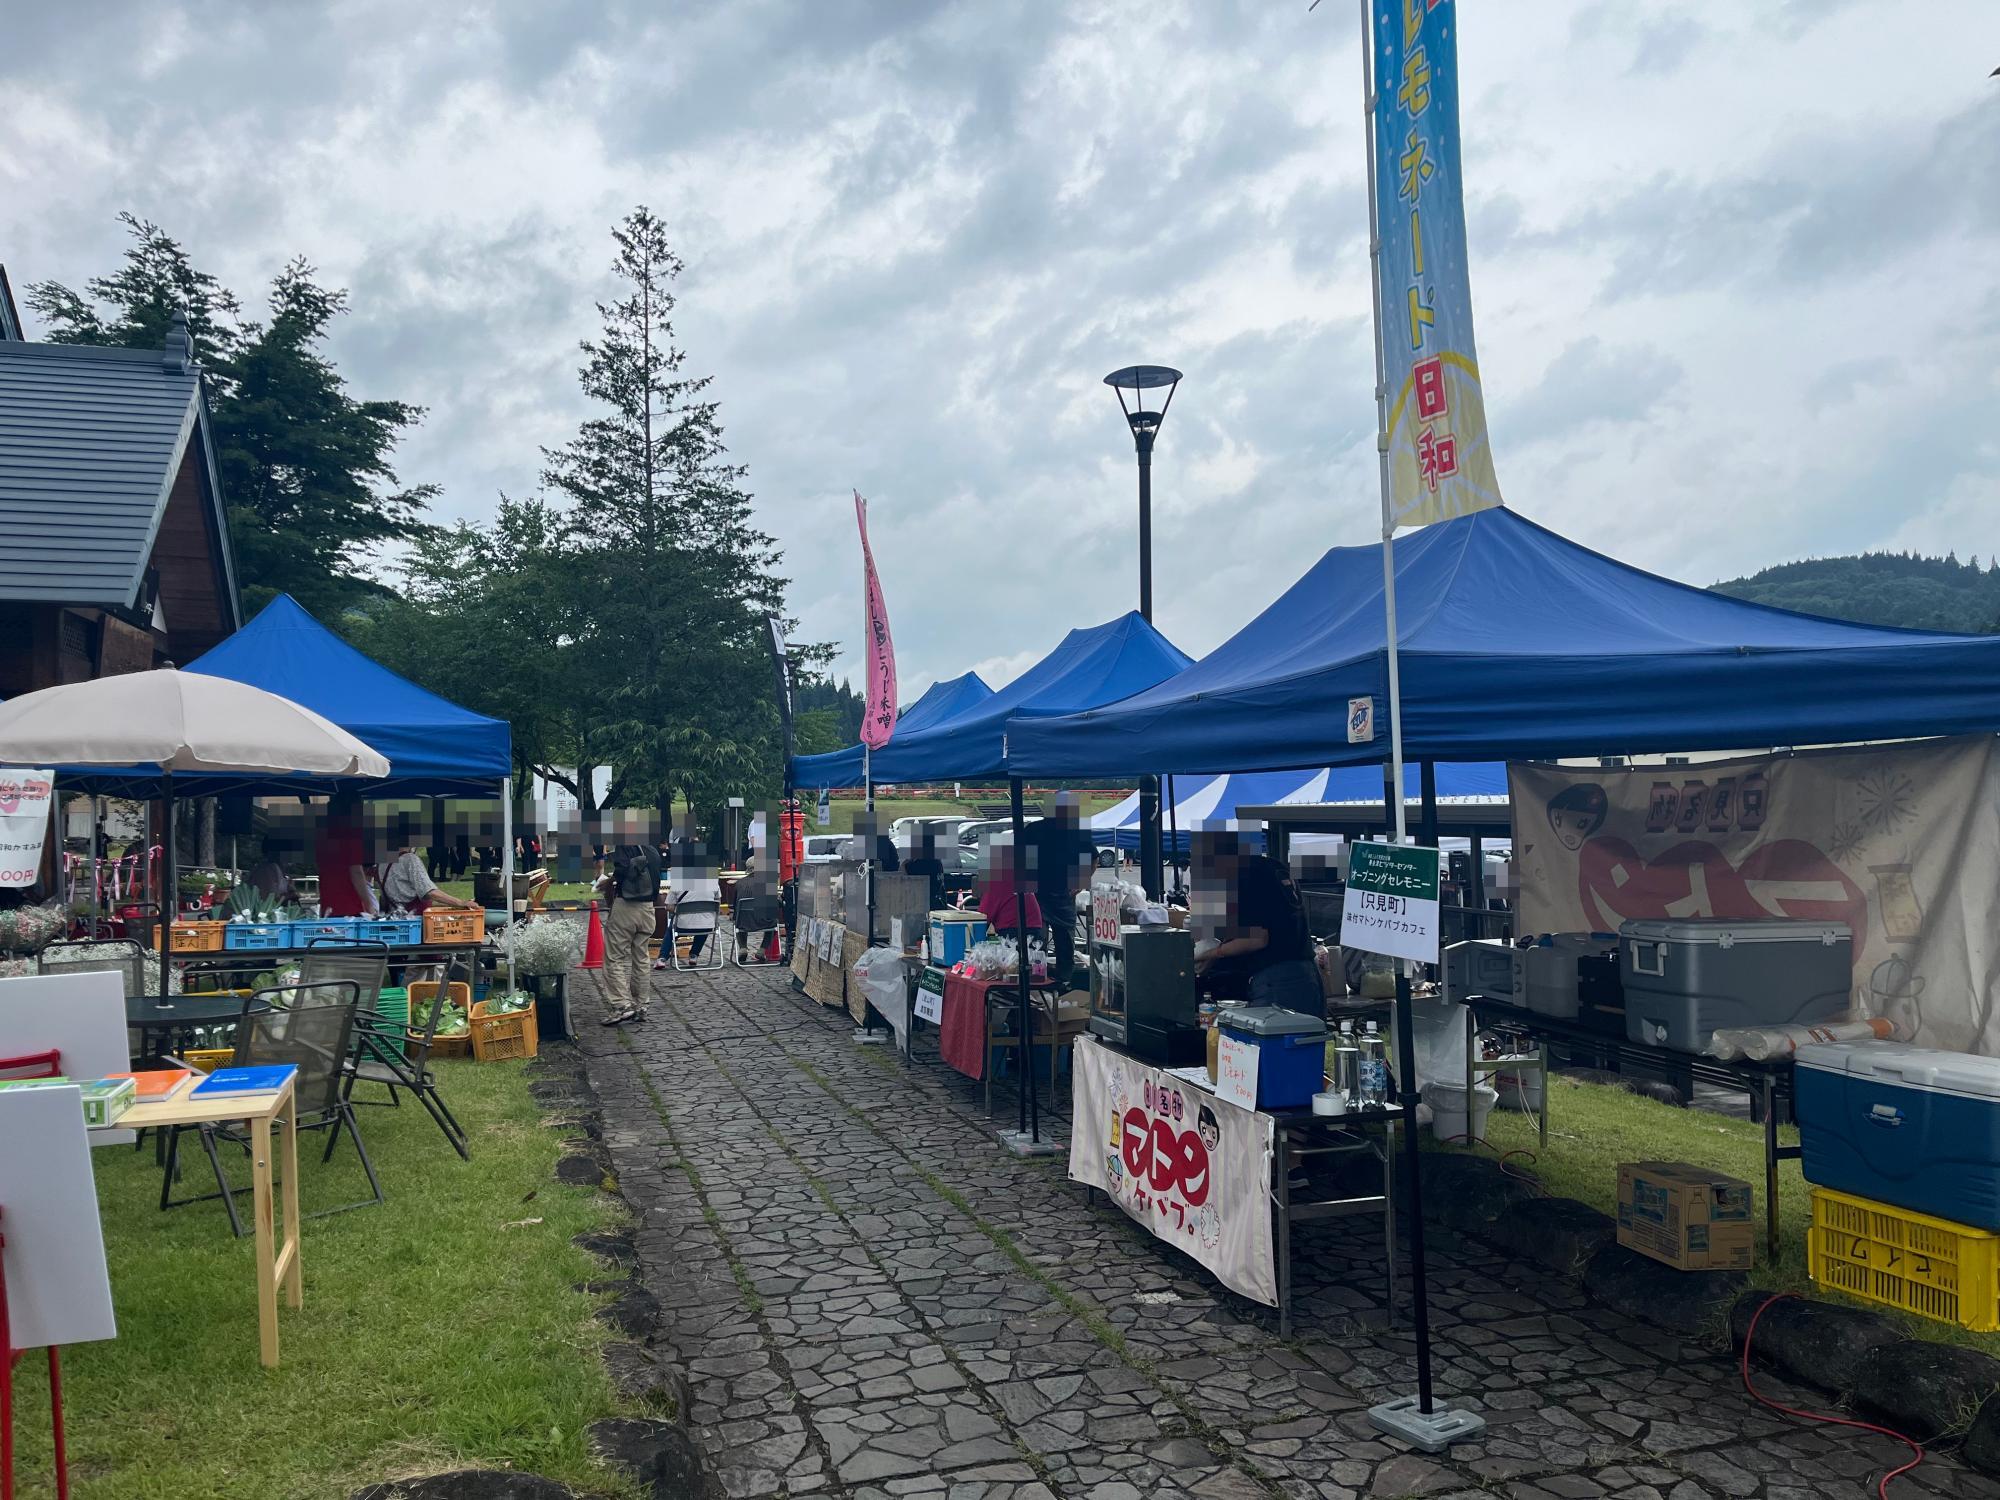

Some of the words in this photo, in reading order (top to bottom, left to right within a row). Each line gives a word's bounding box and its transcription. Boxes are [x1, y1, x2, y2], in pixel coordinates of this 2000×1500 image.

[1351, 870, 1431, 889] オープニングセレモニー
[1361, 892, 1406, 915] 【只見町】
[1096, 917, 1117, 941] 600
[1347, 911, 1426, 936] 味付マトンケバブカフェ
[1126, 1122, 1206, 1192] マトン
